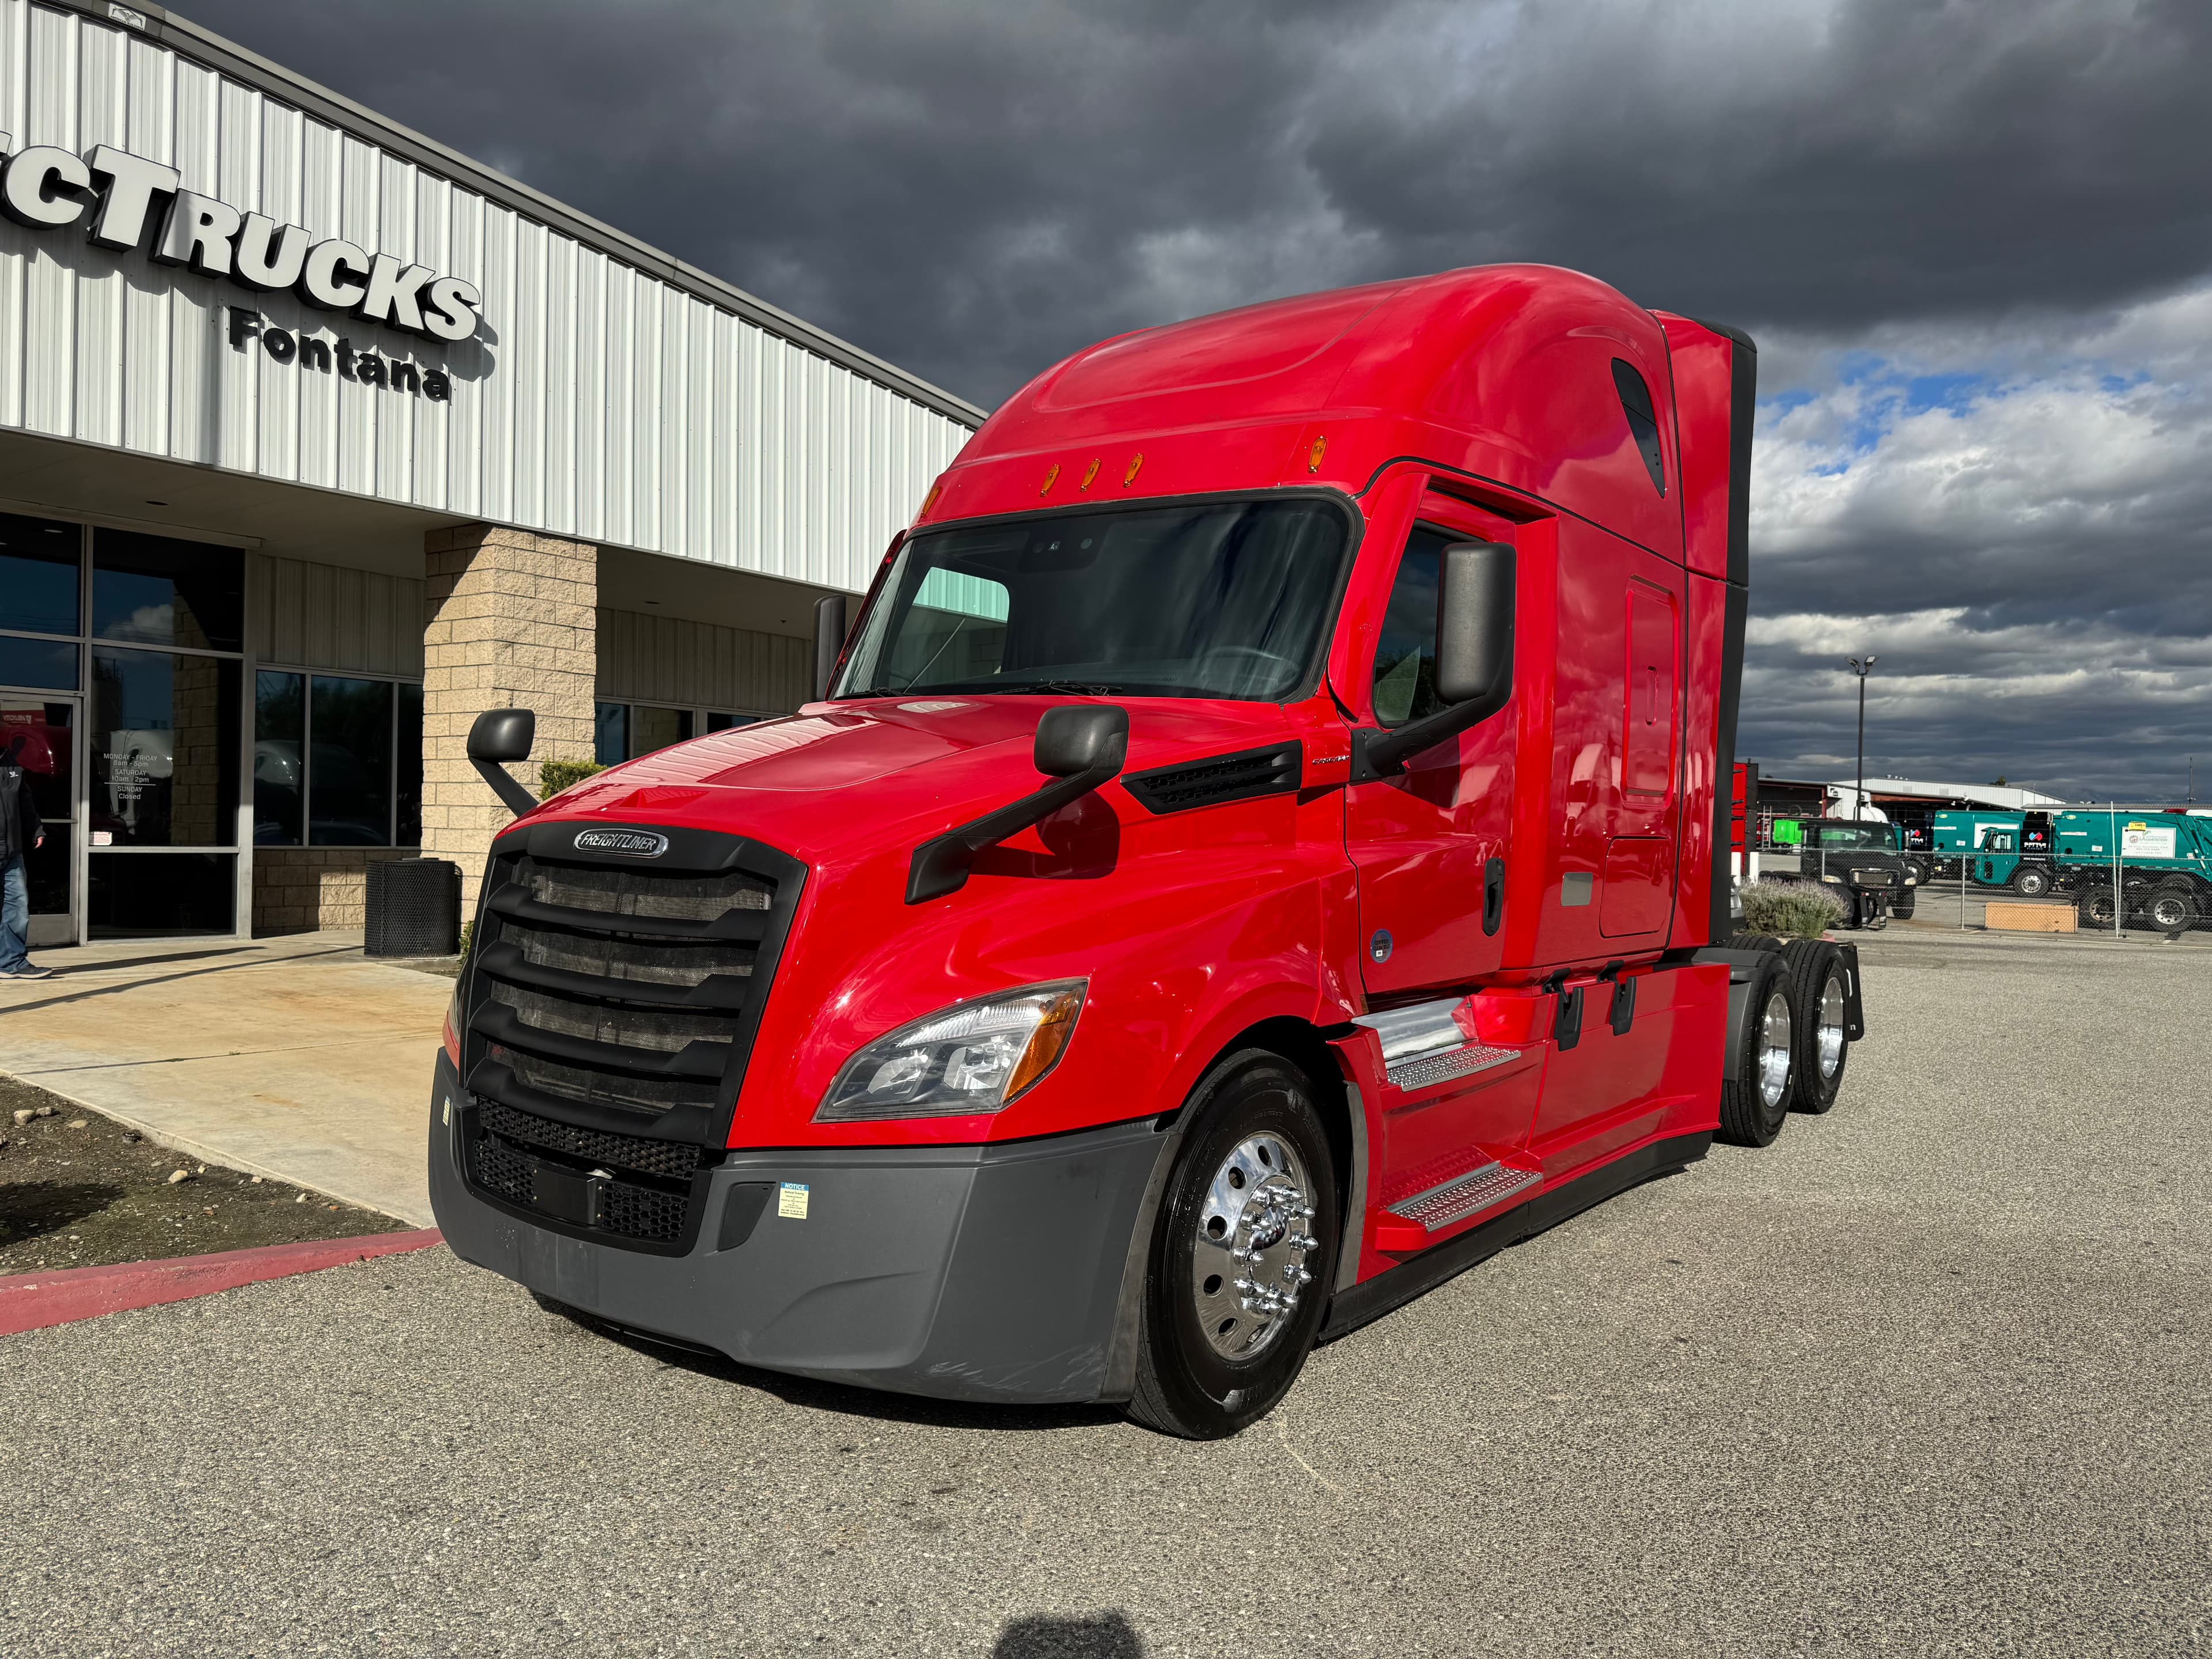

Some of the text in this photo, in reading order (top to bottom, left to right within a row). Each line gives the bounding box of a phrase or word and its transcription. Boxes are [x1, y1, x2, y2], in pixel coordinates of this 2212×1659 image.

[229, 305, 450, 401] Fontana
[581, 834, 657, 850] FREIGHTLINER
[785, 1182, 805, 1190] NOTICE
